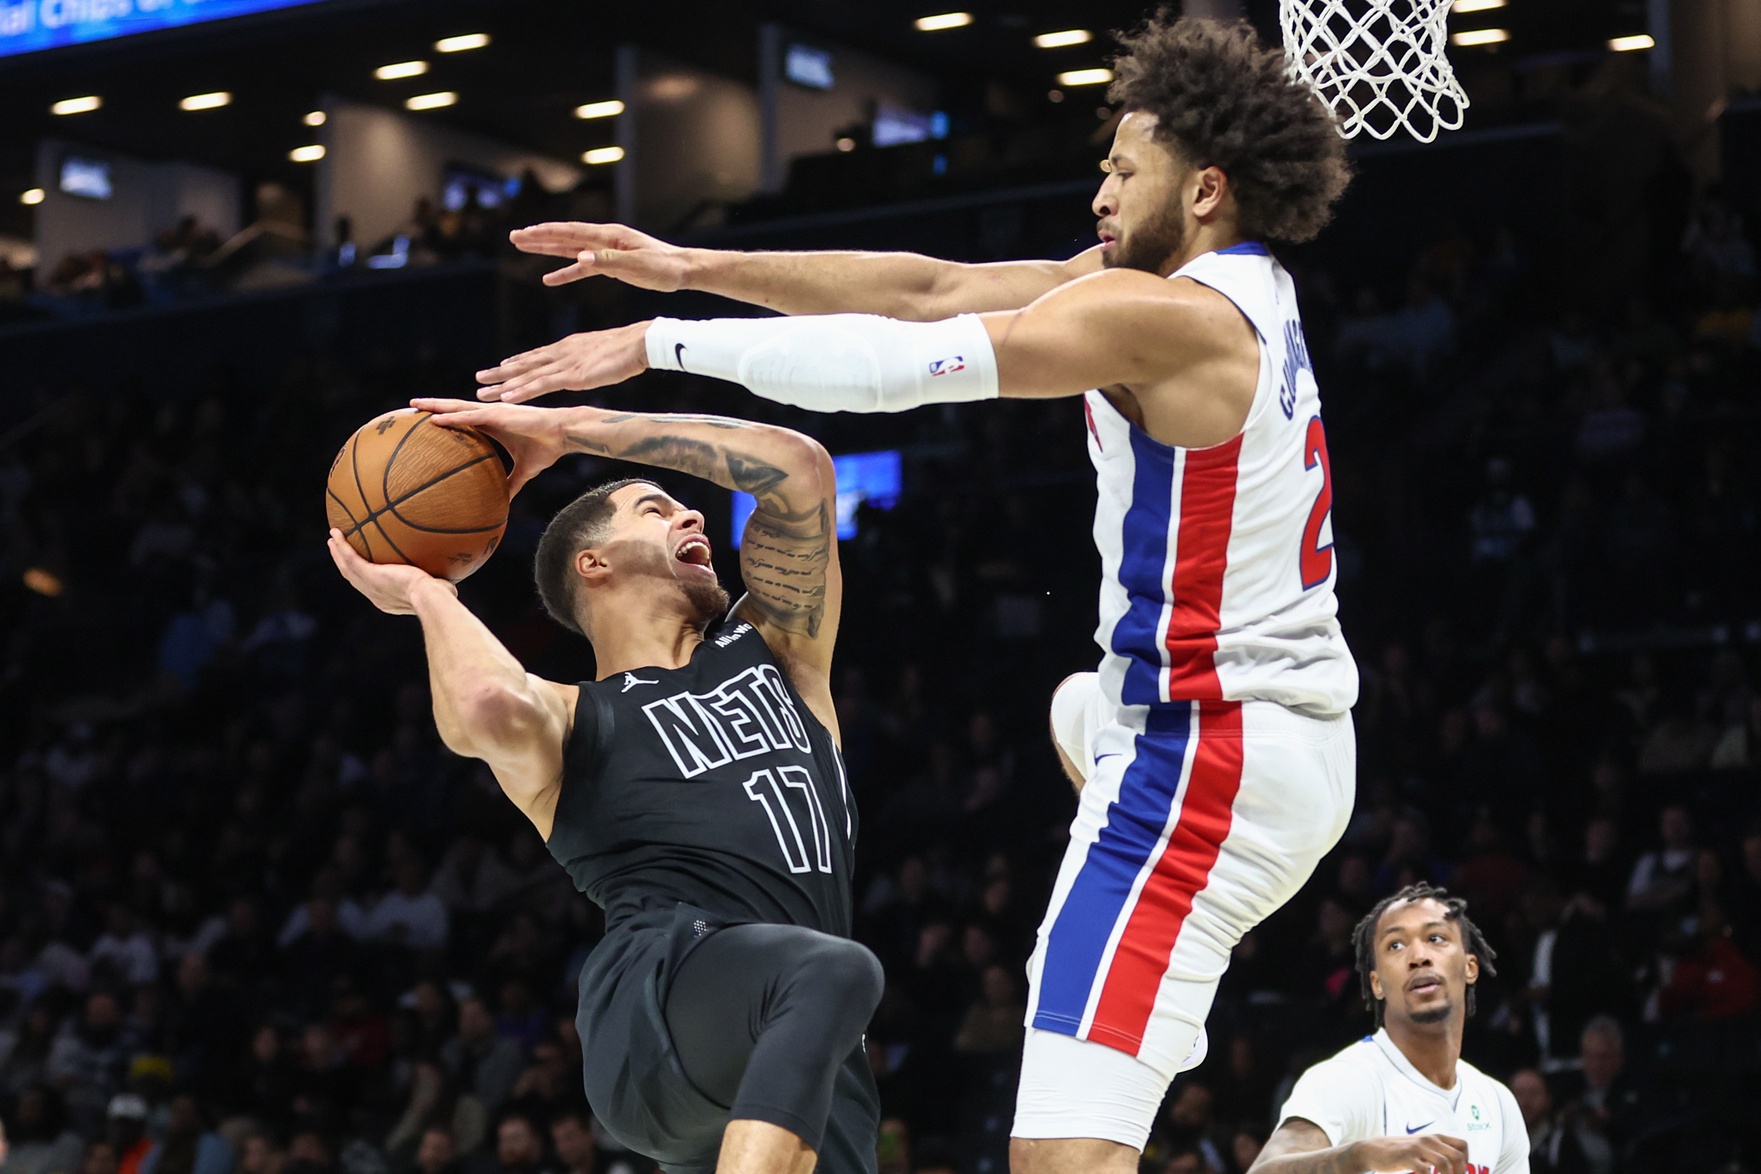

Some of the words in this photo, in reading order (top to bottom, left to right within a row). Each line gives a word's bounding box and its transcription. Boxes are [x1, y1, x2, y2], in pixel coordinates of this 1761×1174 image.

[1299, 414, 1334, 592] 2
[714, 635, 733, 648] All
[641, 663, 812, 779] NETS
[742, 765, 832, 874] 17
